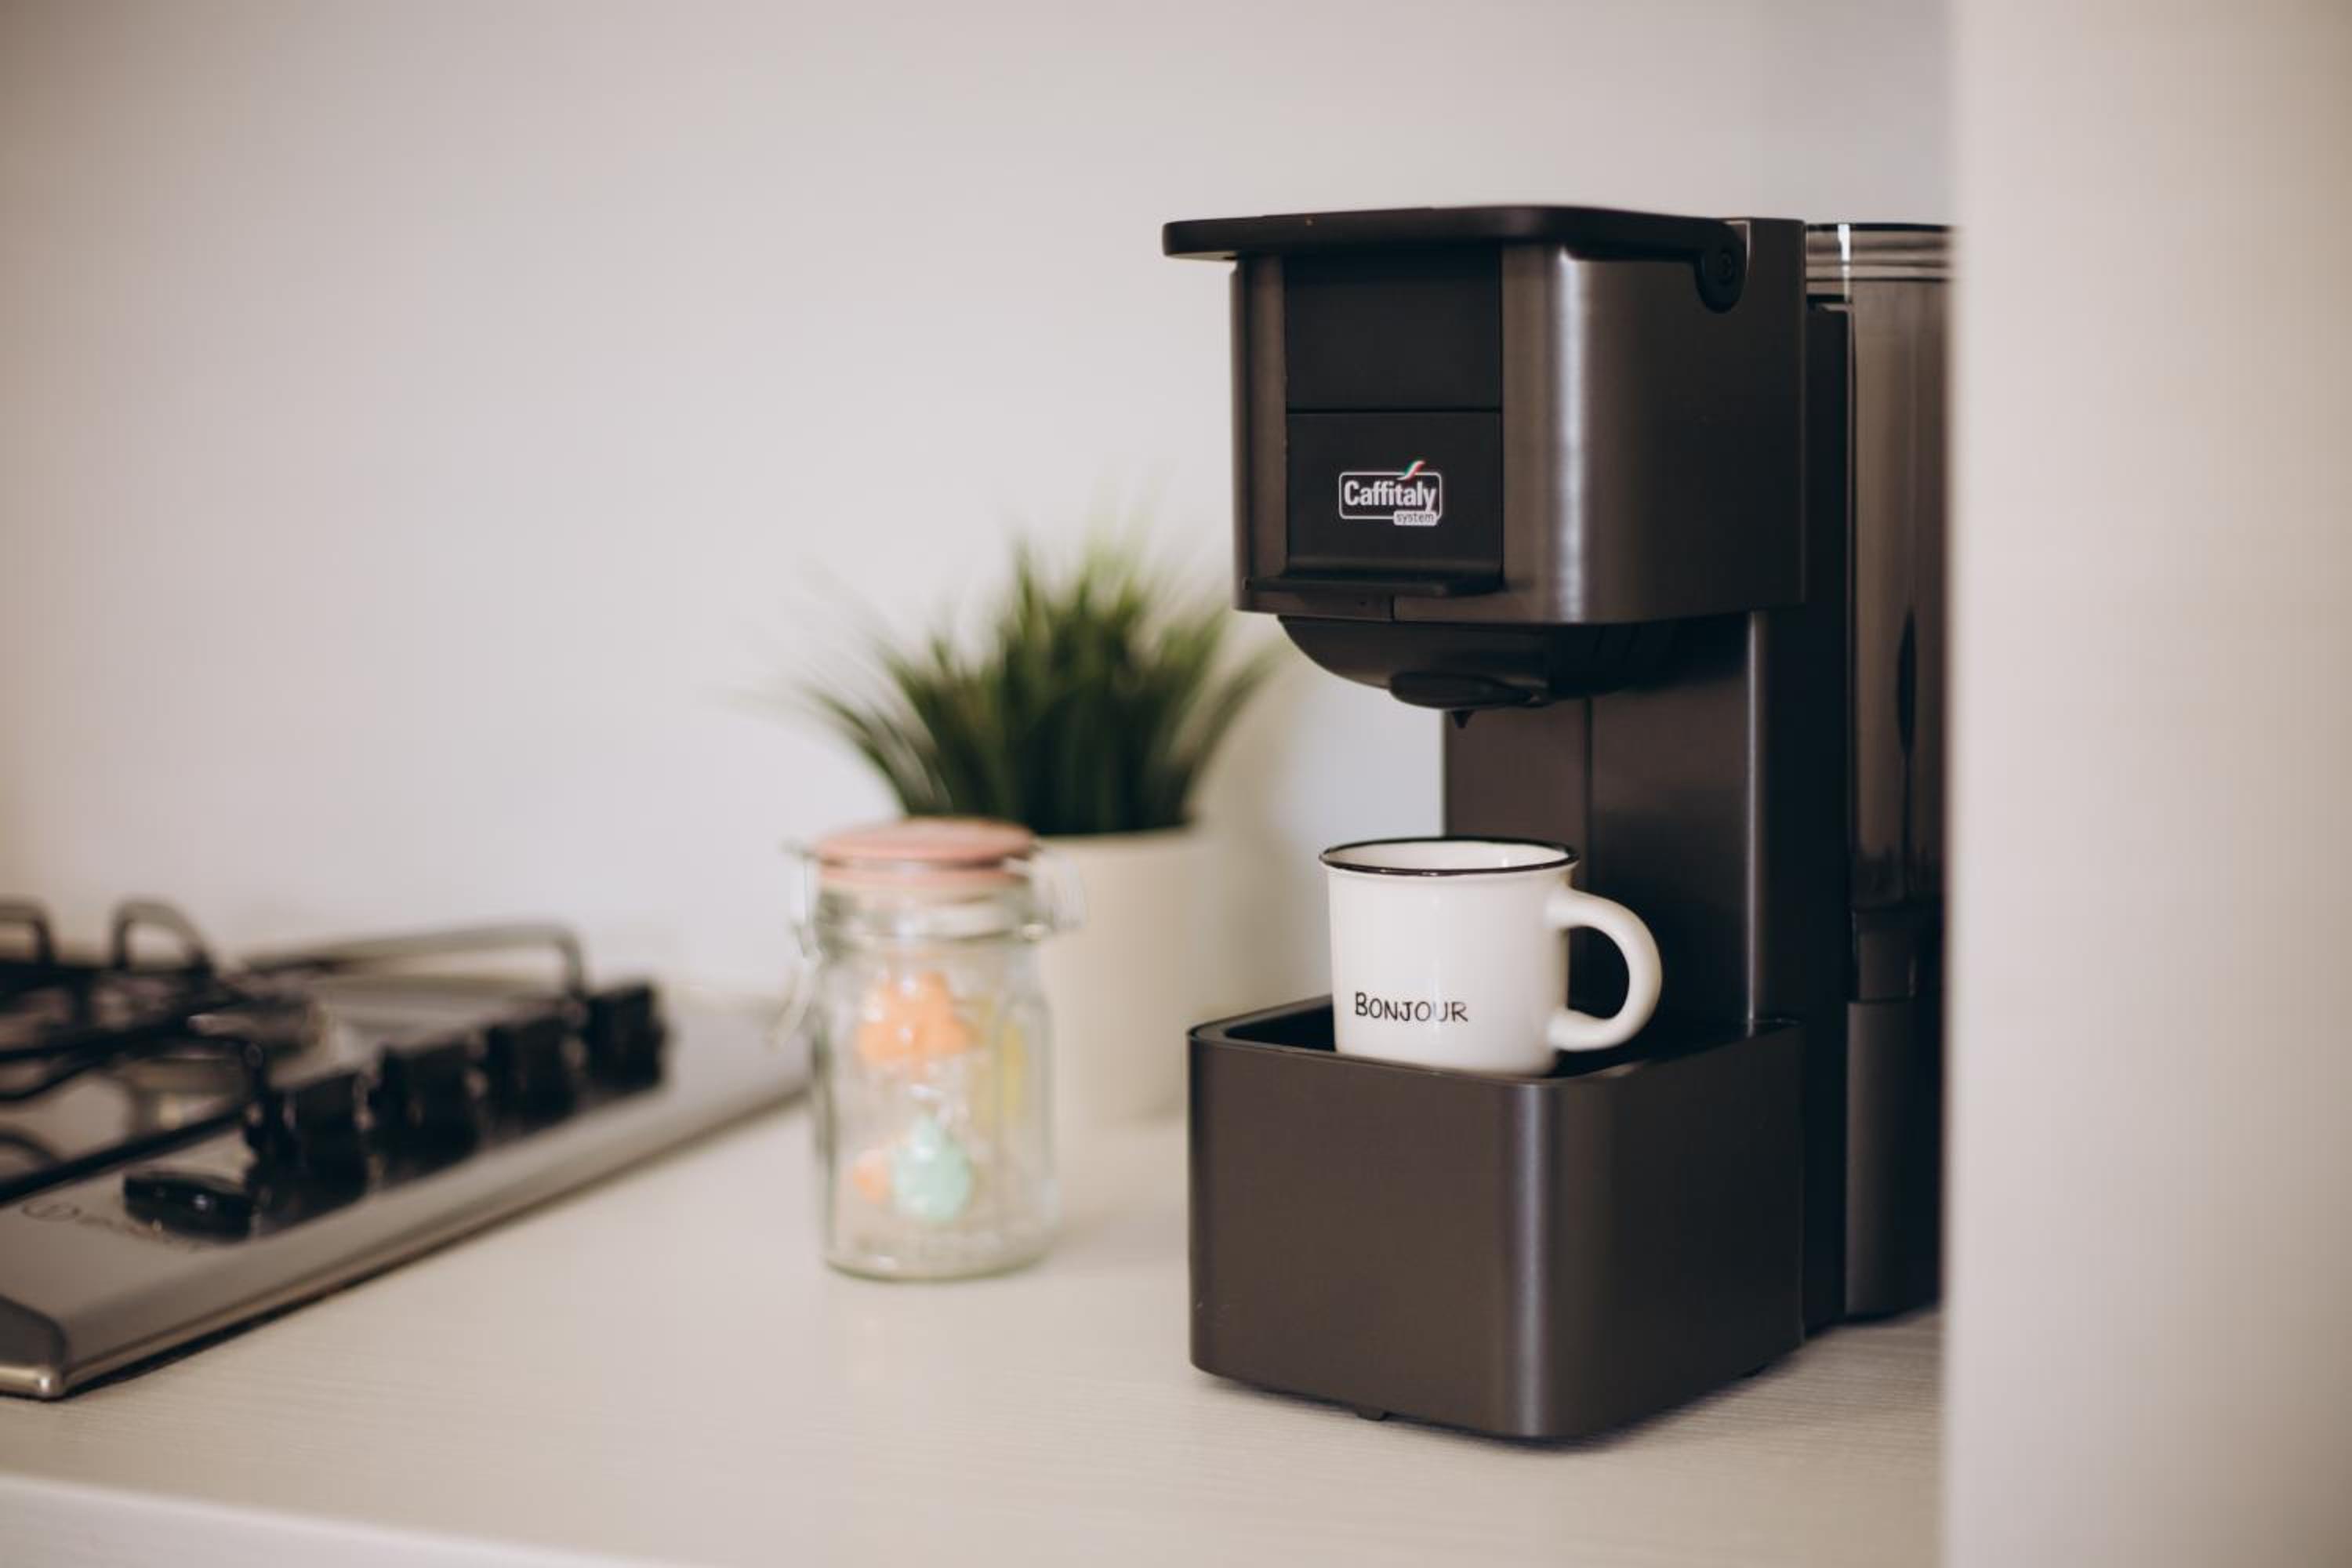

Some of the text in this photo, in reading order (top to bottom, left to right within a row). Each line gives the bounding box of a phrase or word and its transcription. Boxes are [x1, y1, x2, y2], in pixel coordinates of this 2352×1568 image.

[1344, 480, 1436, 512] Caffitaly
[1396, 513, 1435, 523] system
[1355, 991, 1468, 1022] BONJOUR
